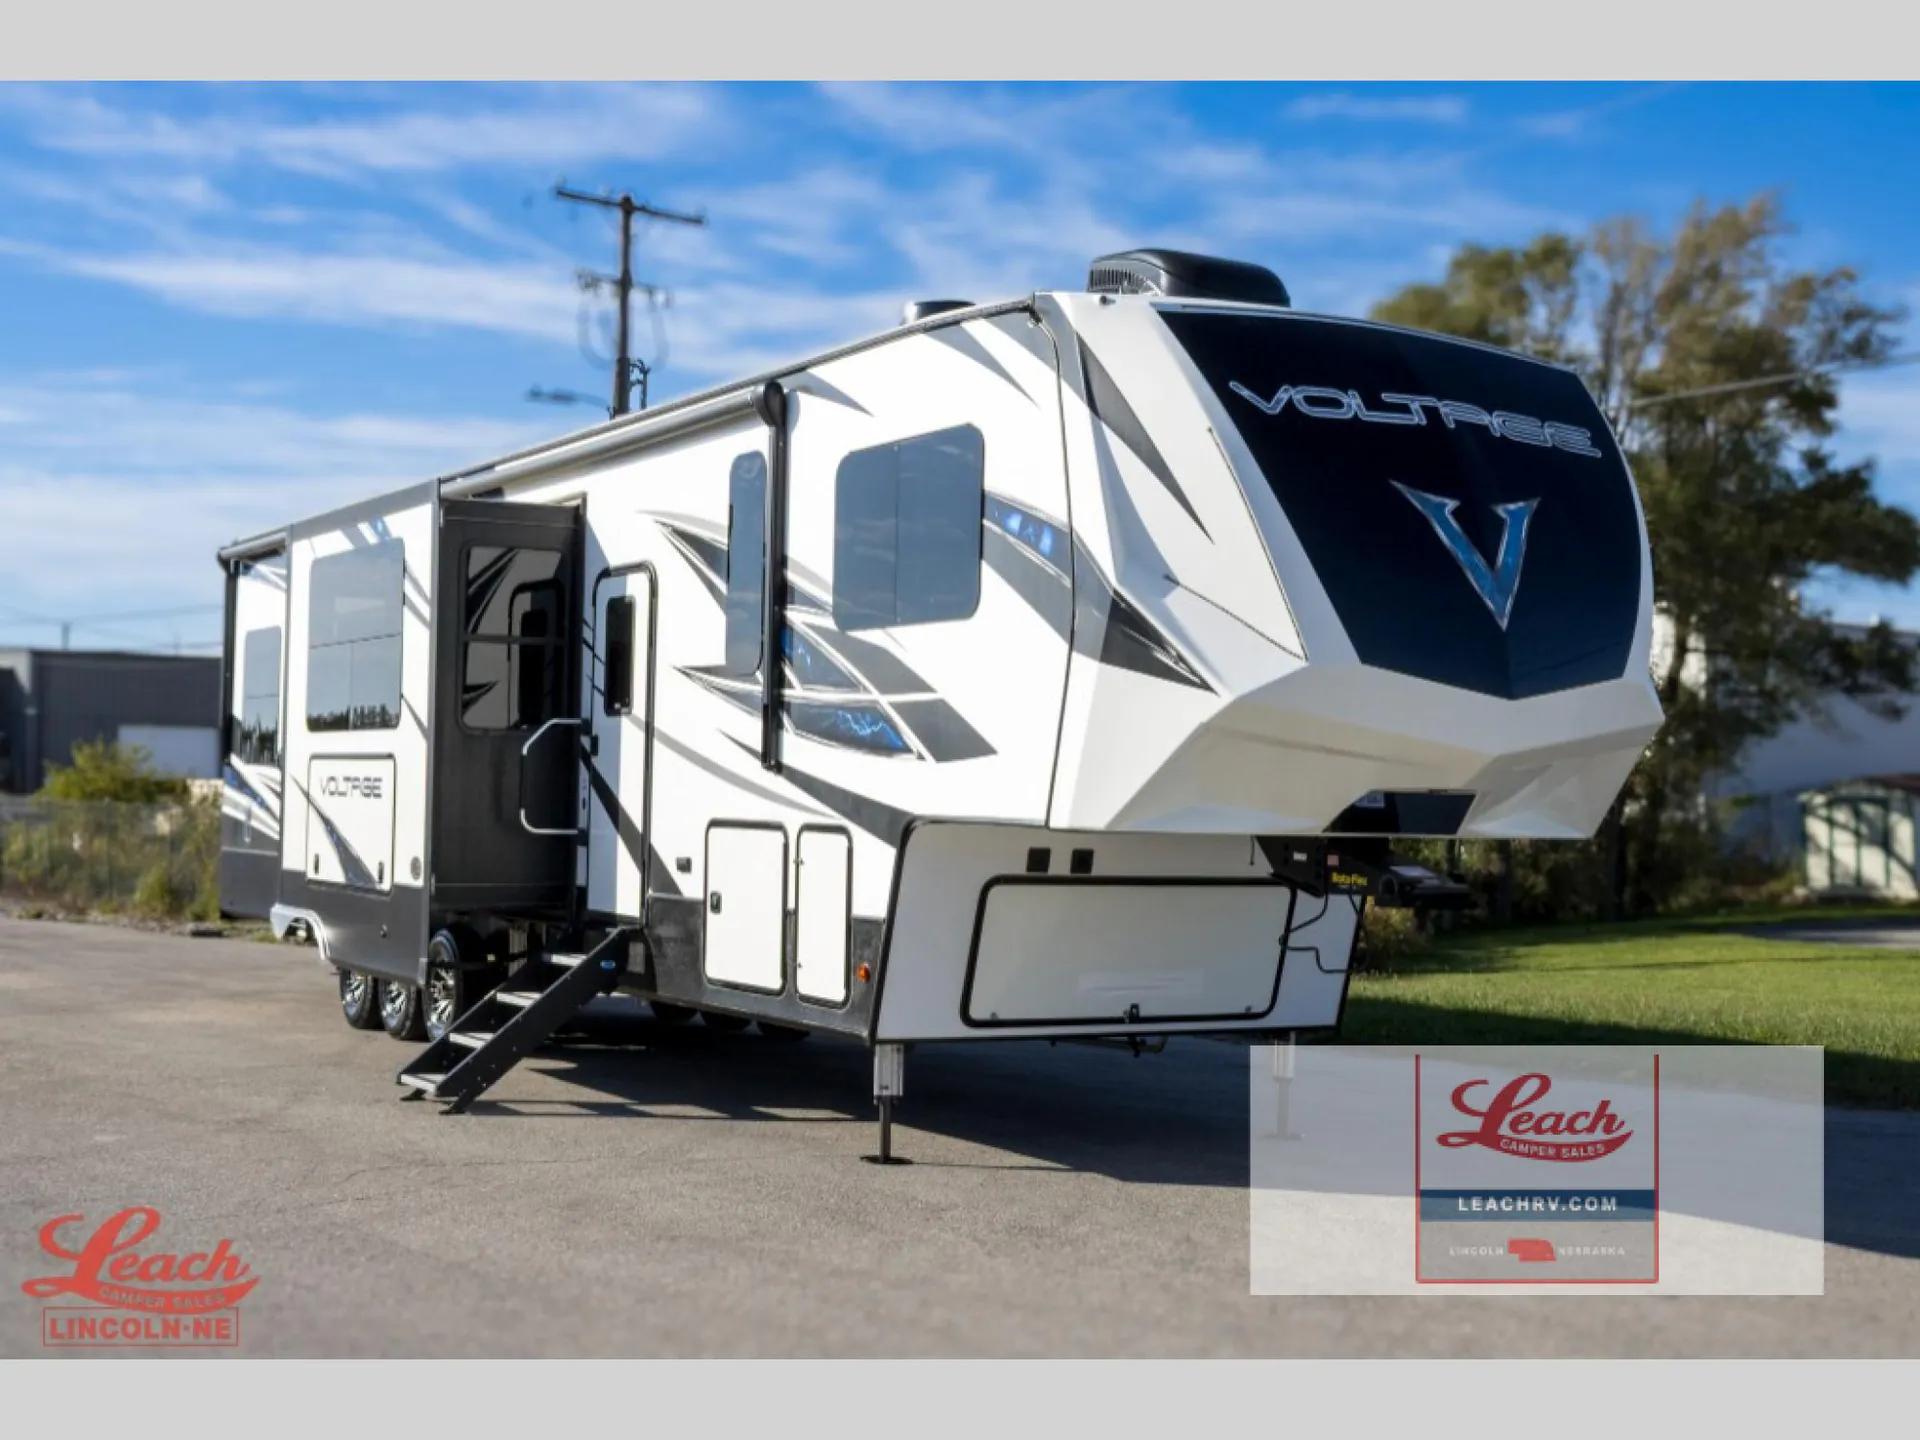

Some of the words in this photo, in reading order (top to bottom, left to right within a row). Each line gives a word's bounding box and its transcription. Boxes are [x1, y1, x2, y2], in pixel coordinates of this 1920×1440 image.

[1228, 381, 1602, 458] VOLTAGE
[1389, 478, 1541, 632] V
[320, 775, 383, 799] VOLTAGE
